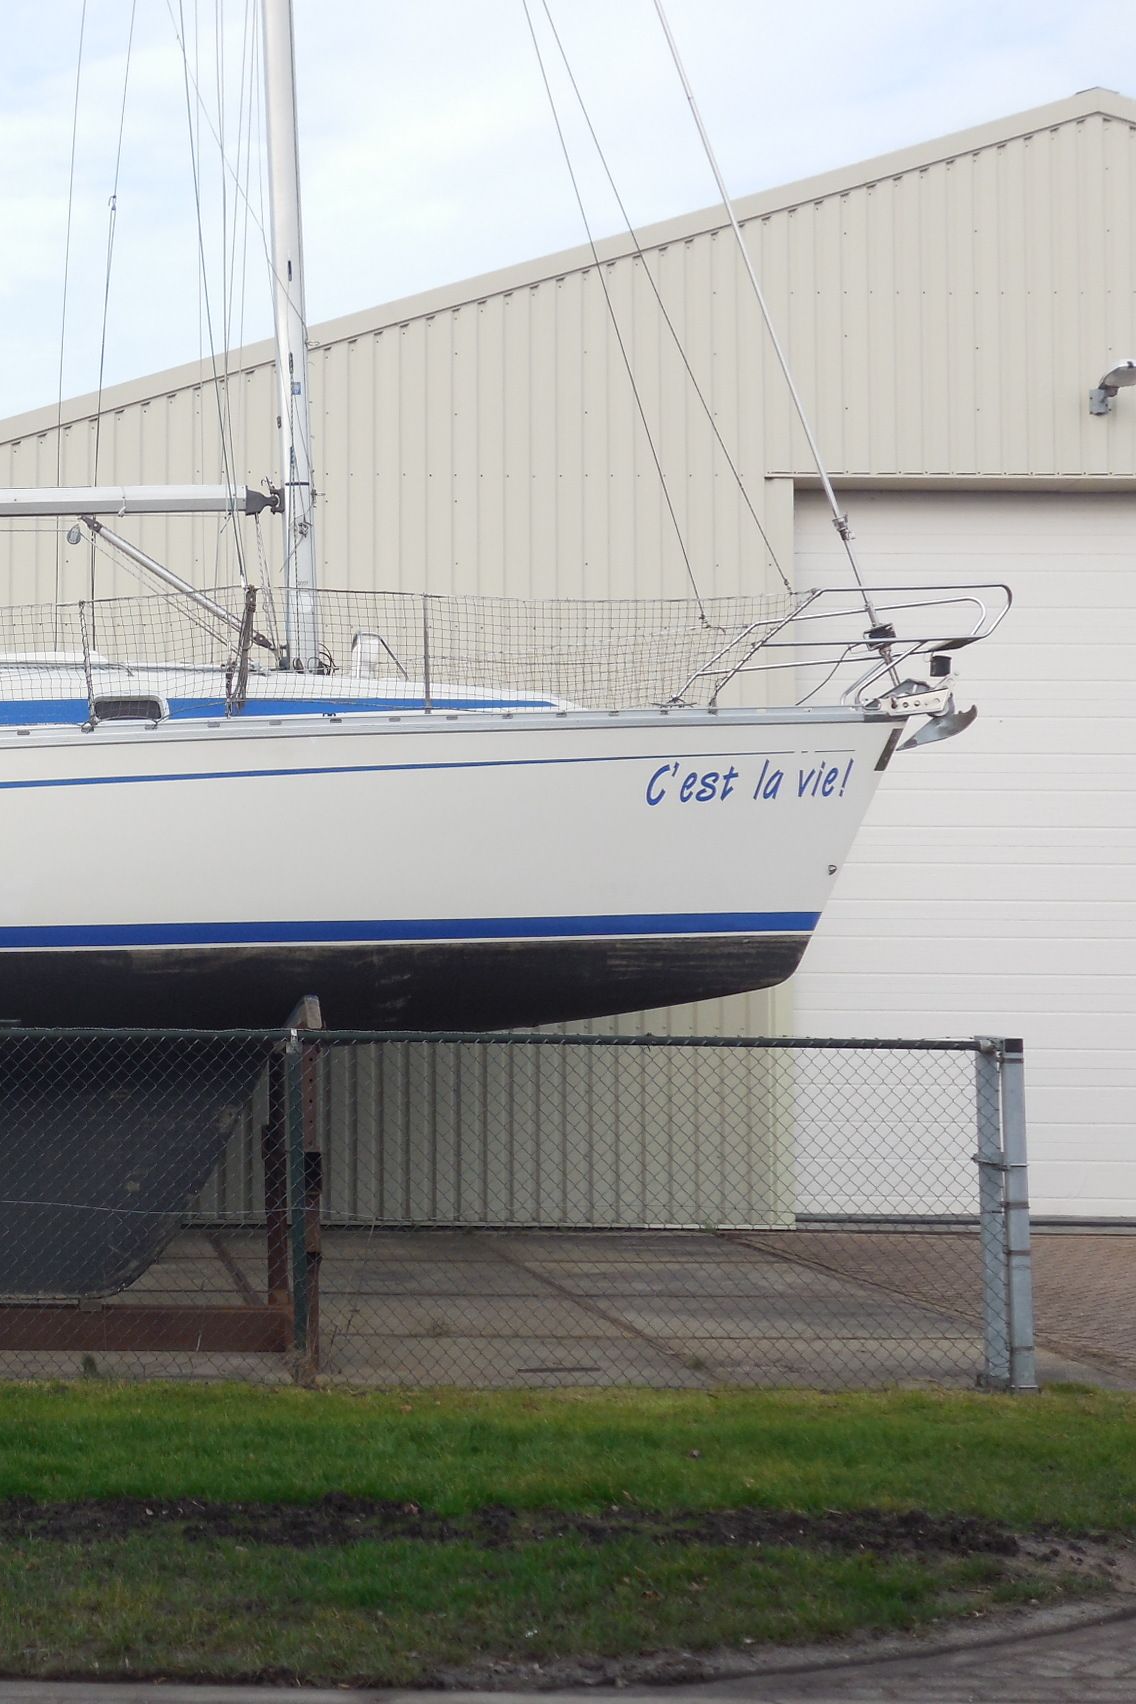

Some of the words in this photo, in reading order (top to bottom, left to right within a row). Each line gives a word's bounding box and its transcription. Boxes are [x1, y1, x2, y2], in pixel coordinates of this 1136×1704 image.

[645, 761, 739, 806] C'est
[753, 759, 784, 800] la
[797, 758, 854, 798] vie!
